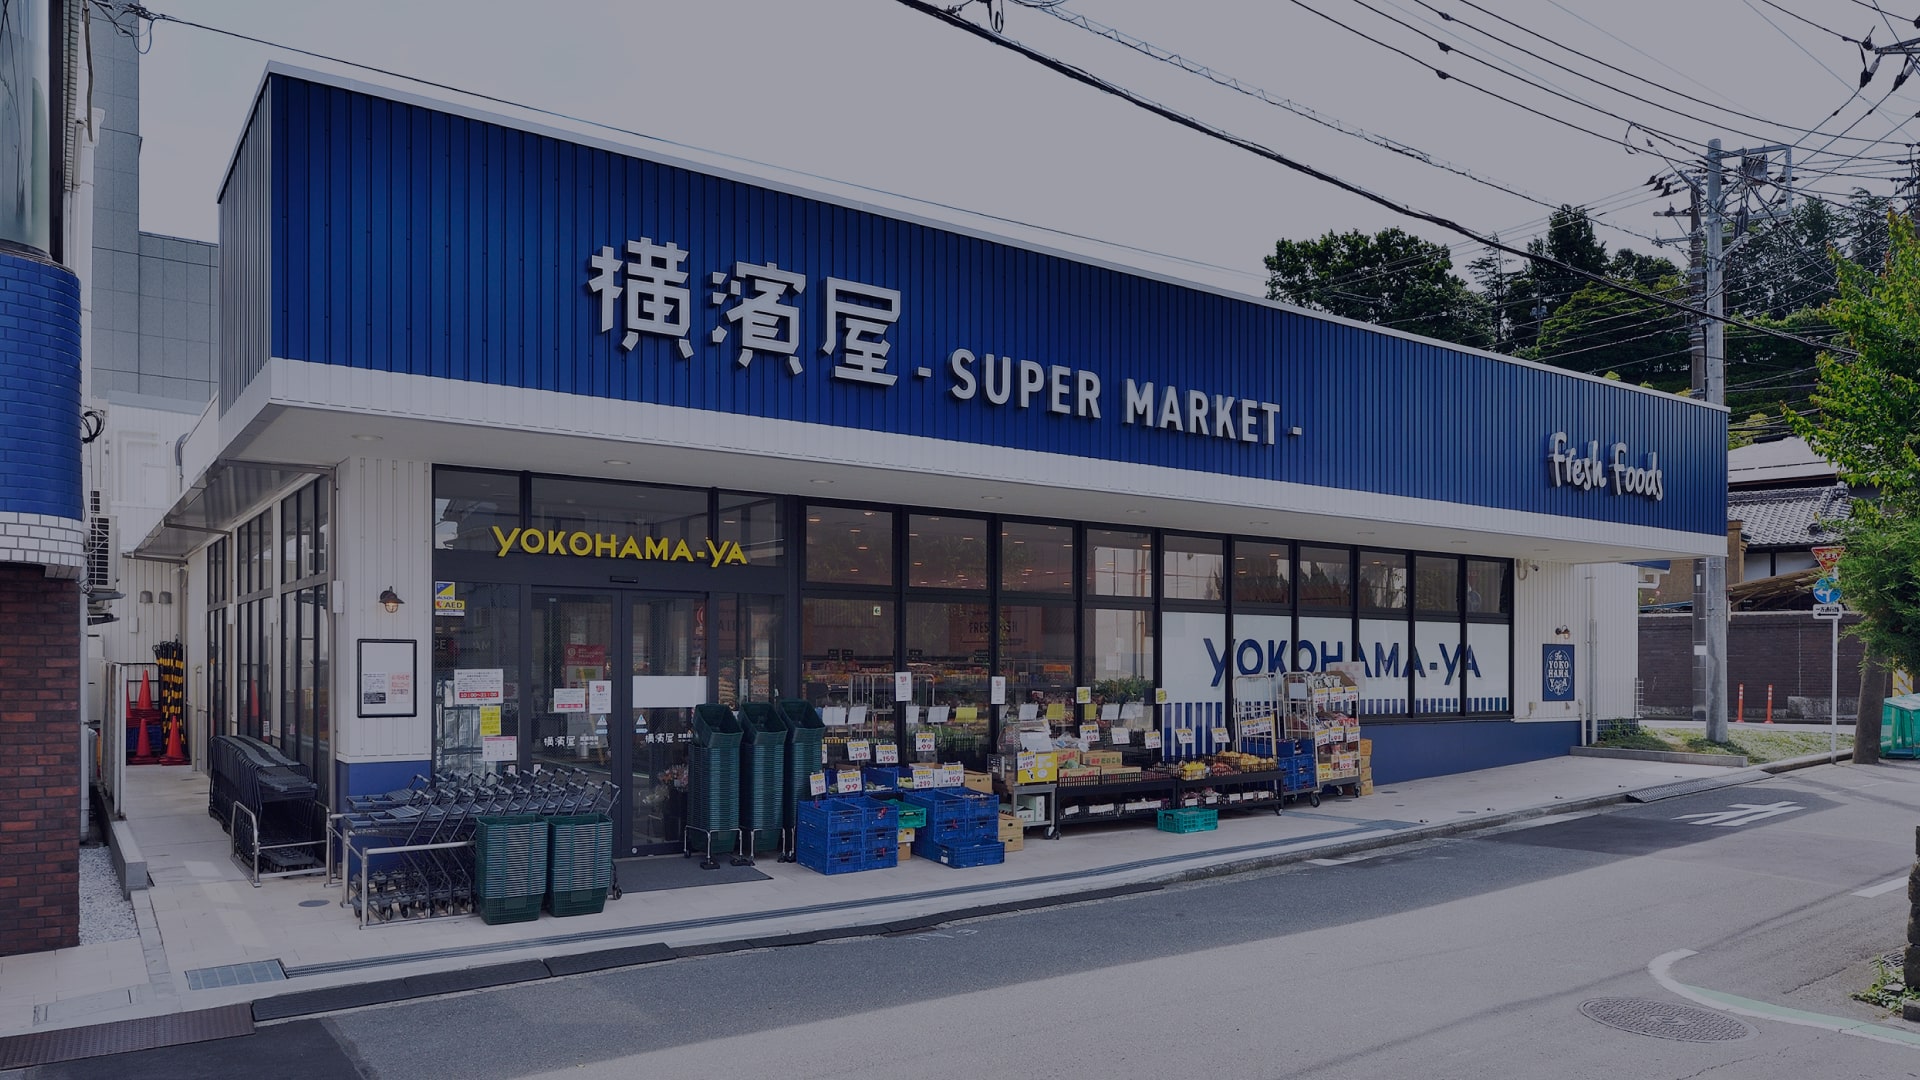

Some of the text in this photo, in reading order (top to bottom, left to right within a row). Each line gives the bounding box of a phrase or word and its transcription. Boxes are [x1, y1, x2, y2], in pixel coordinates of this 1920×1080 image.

[589, 236, 901, 386] 横濱屋
[949, 348, 1102, 419] SUPER
[1123, 378, 1281, 446] MARKET
[1549, 432, 1664, 501] fresh foods
[492, 525, 748, 568] YOKOHAMA-YA
[444, 601, 463, 609] AED
[1202, 638, 1482, 687] YOKOHAMA-YA
[1548, 661, 1569, 669] YOKO
[1548, 669, 1569, 678] HAMA
